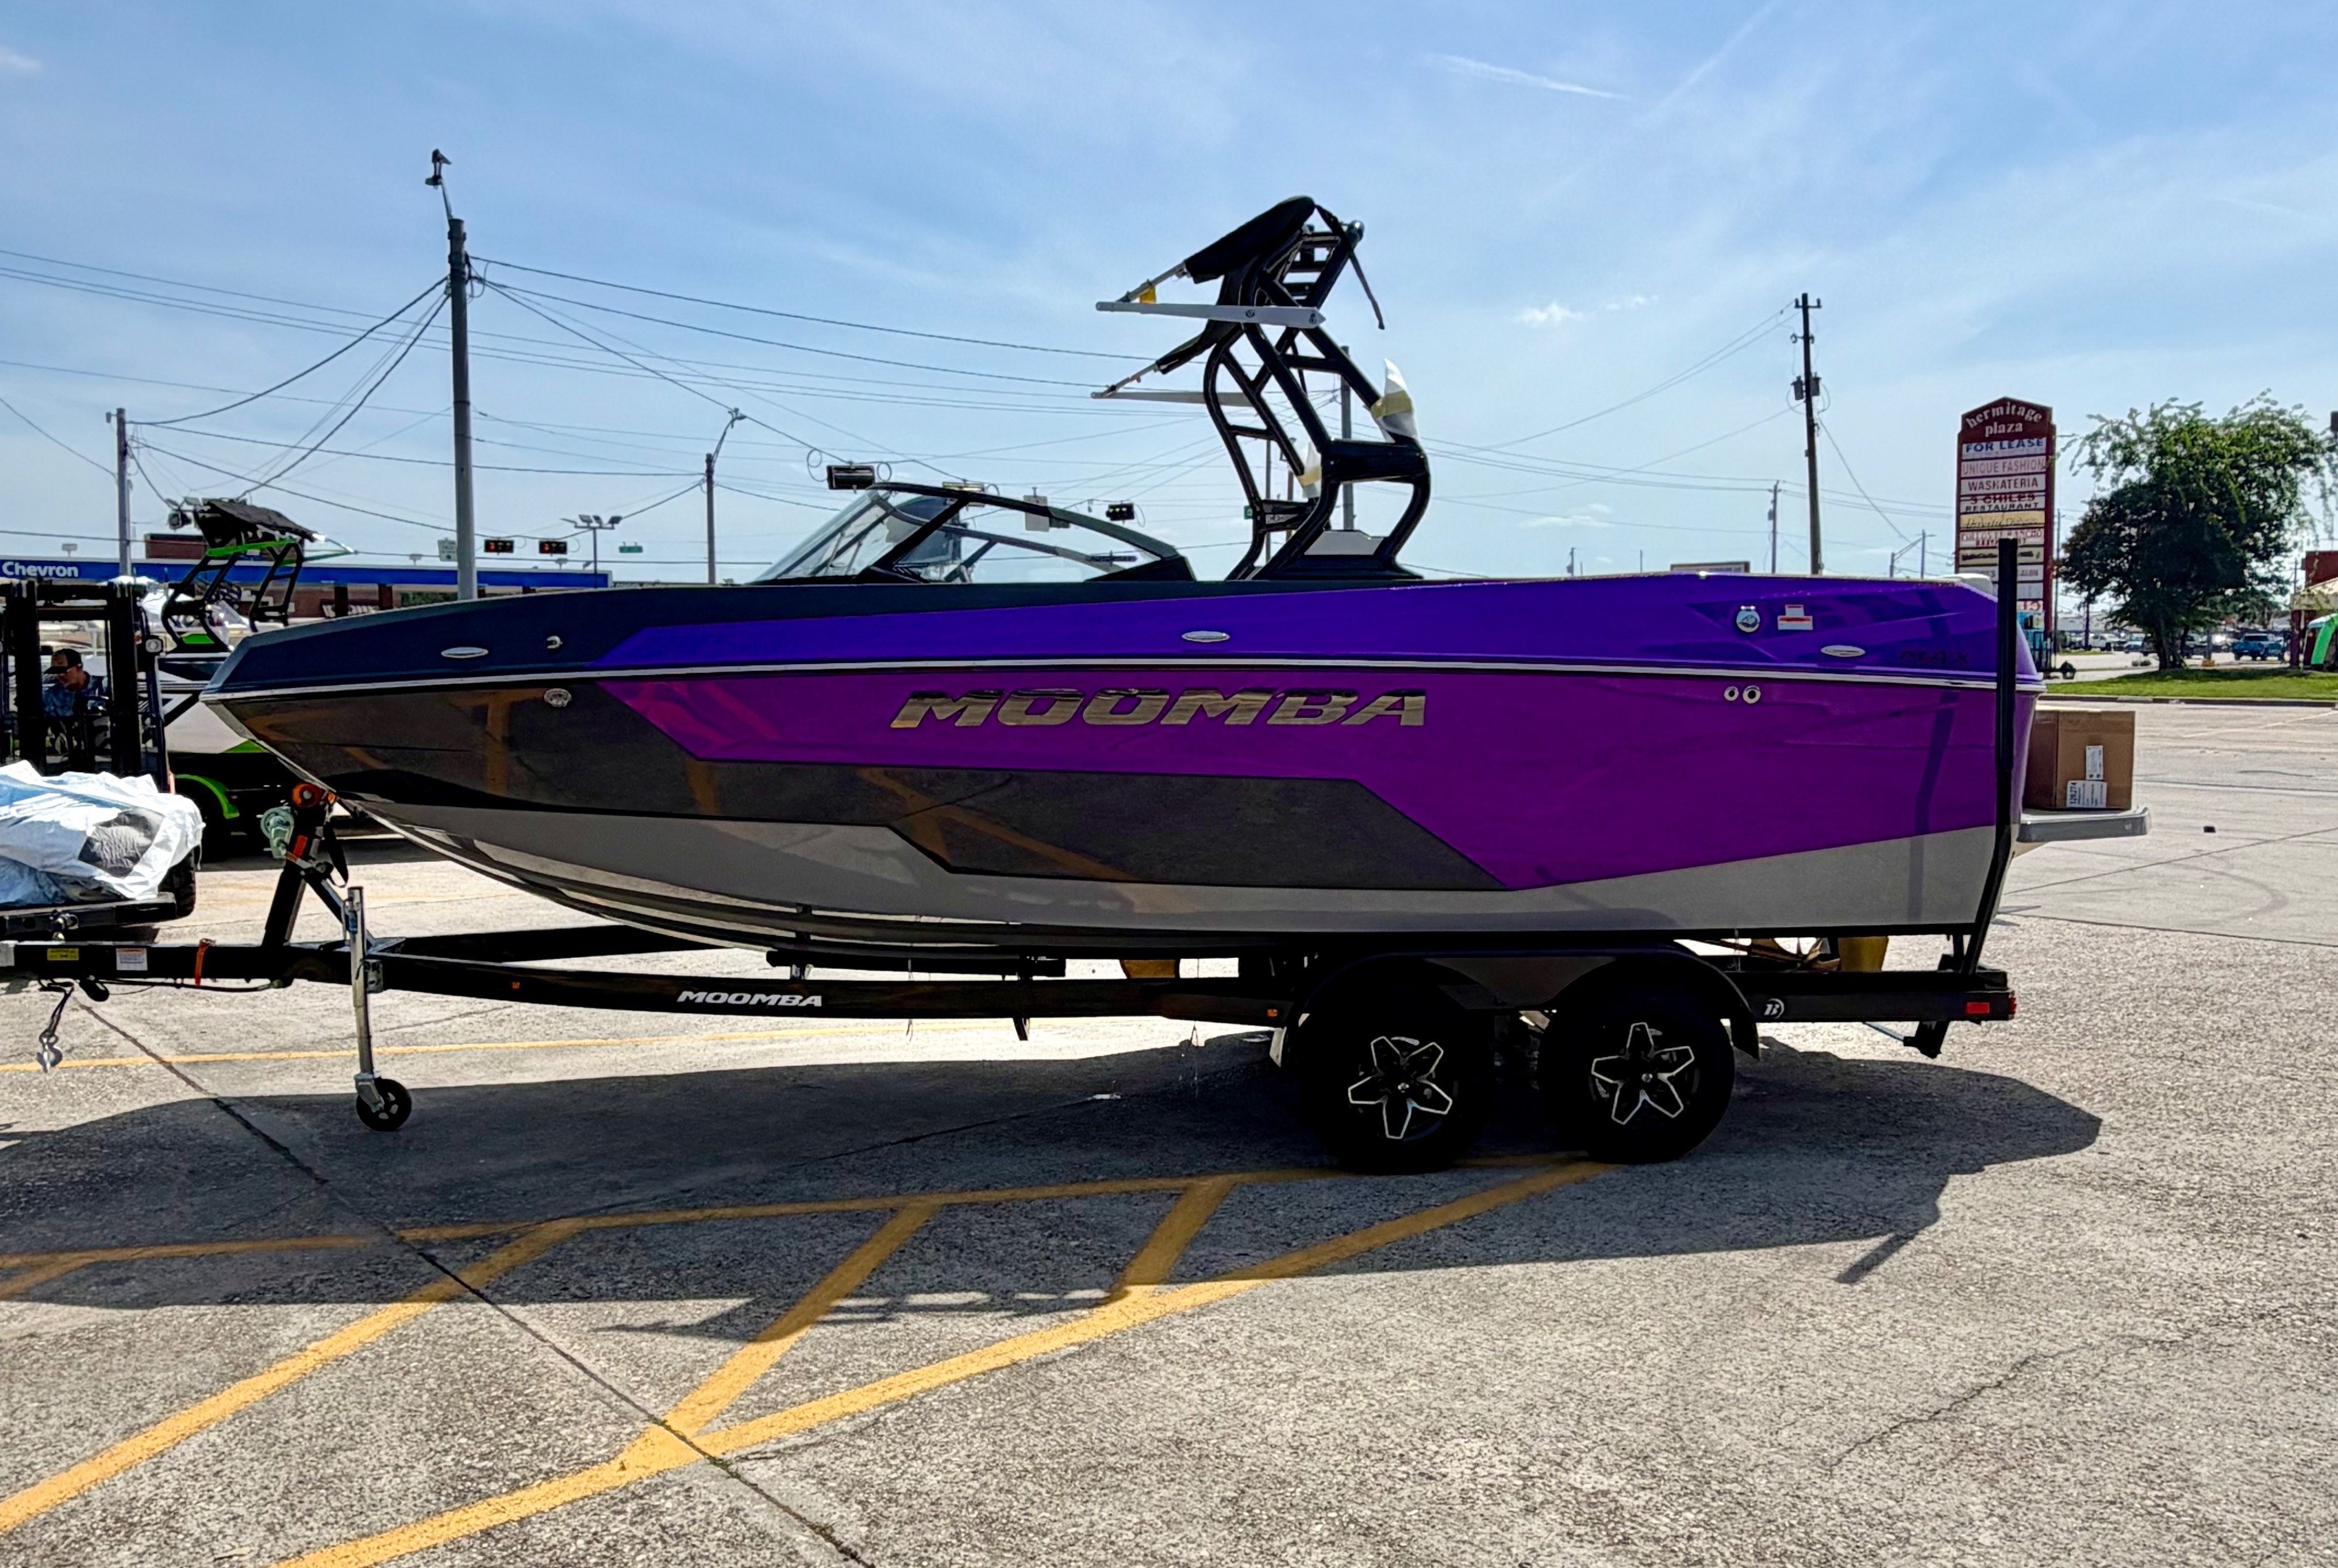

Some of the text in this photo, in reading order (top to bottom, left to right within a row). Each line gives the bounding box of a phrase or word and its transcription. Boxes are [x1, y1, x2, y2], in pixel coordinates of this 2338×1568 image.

[1966, 402, 2043, 429] hermitage
[1985, 421, 2024, 438] plaza
[1966, 437, 2044, 453] FOR LEASE
[1962, 462, 1999, 475] UNIQUE
[1968, 477, 2039, 491] WASHATERIA
[2, 561, 79, 577] Chevron
[890, 689, 1426, 728] MOOMBA
[676, 991, 822, 1007] MOOMBA
